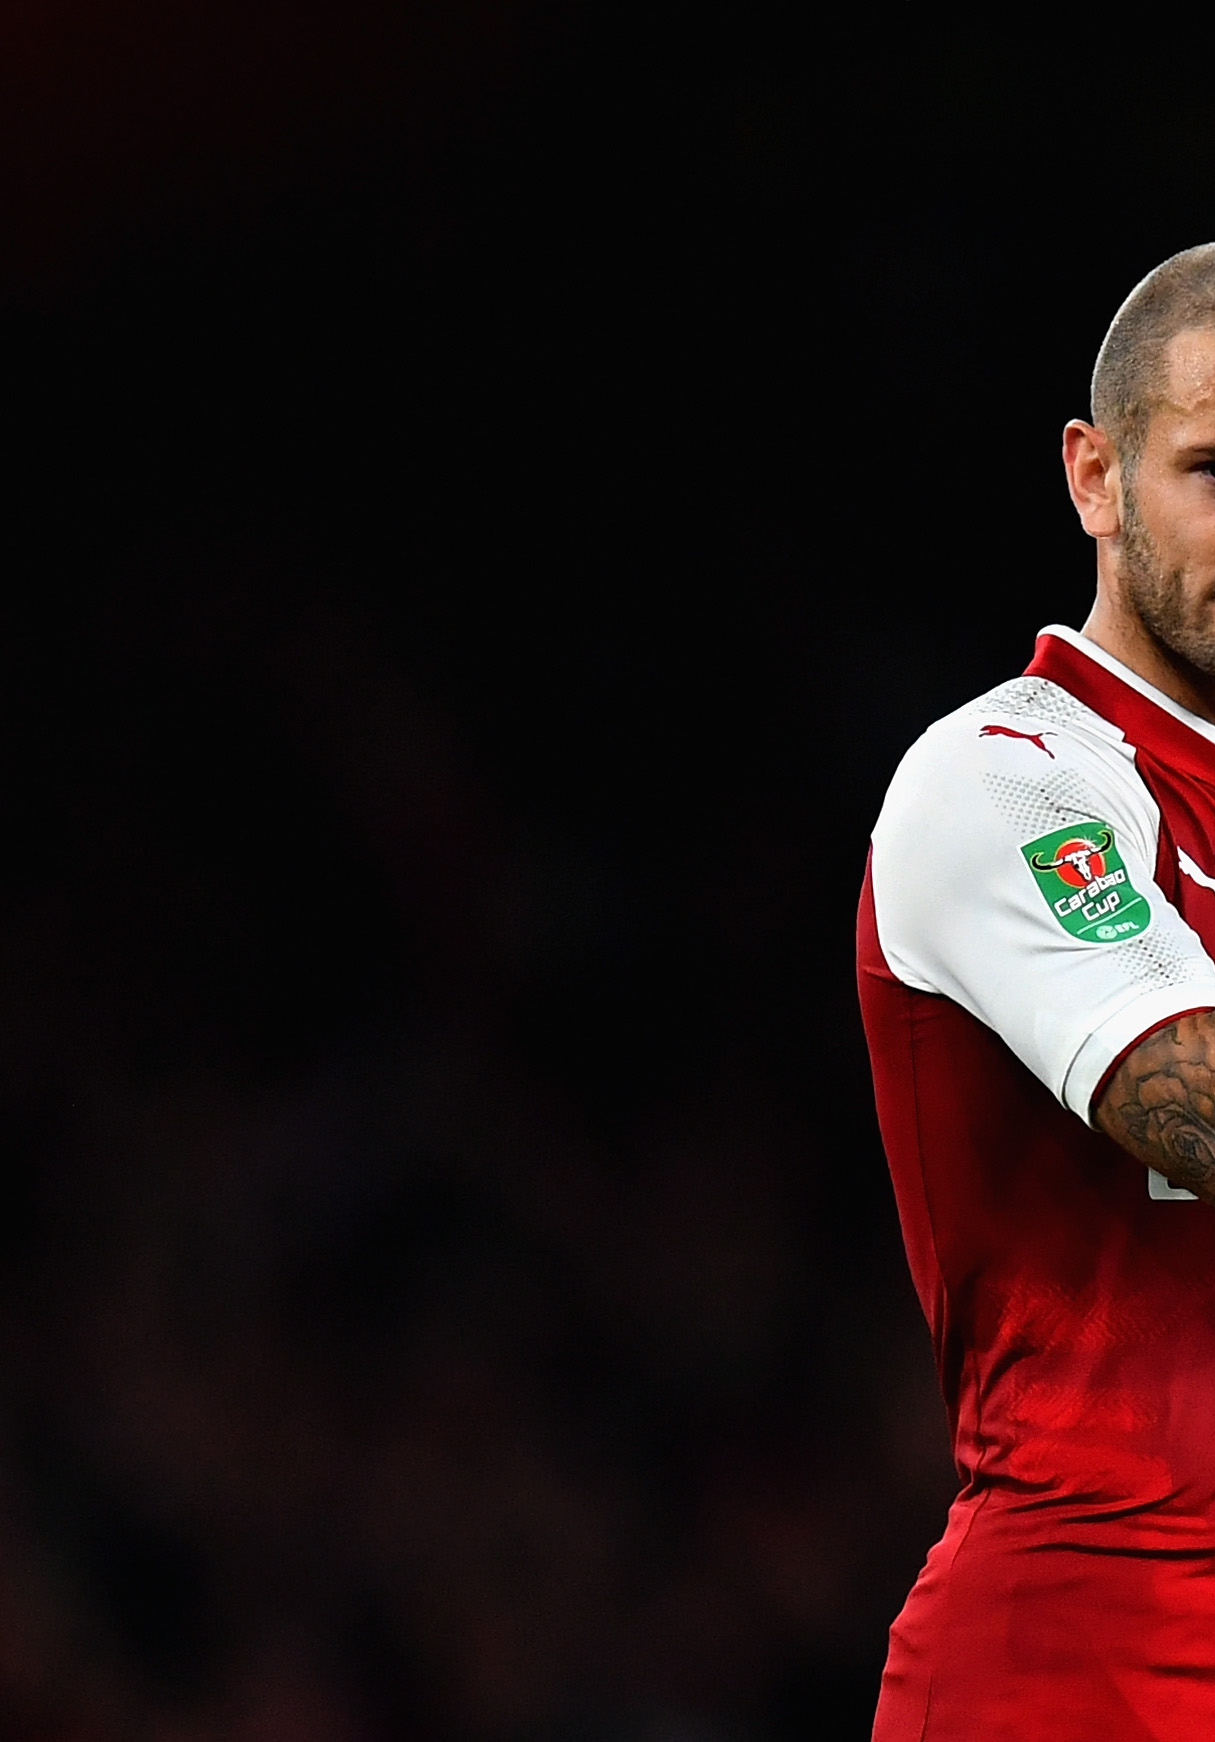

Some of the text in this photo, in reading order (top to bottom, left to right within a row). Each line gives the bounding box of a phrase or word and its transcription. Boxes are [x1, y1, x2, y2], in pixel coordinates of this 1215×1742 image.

[1054, 868, 1126, 917] Carabao
[1081, 891, 1121, 921] Cup
[1114, 921, 1140, 933] EFL
